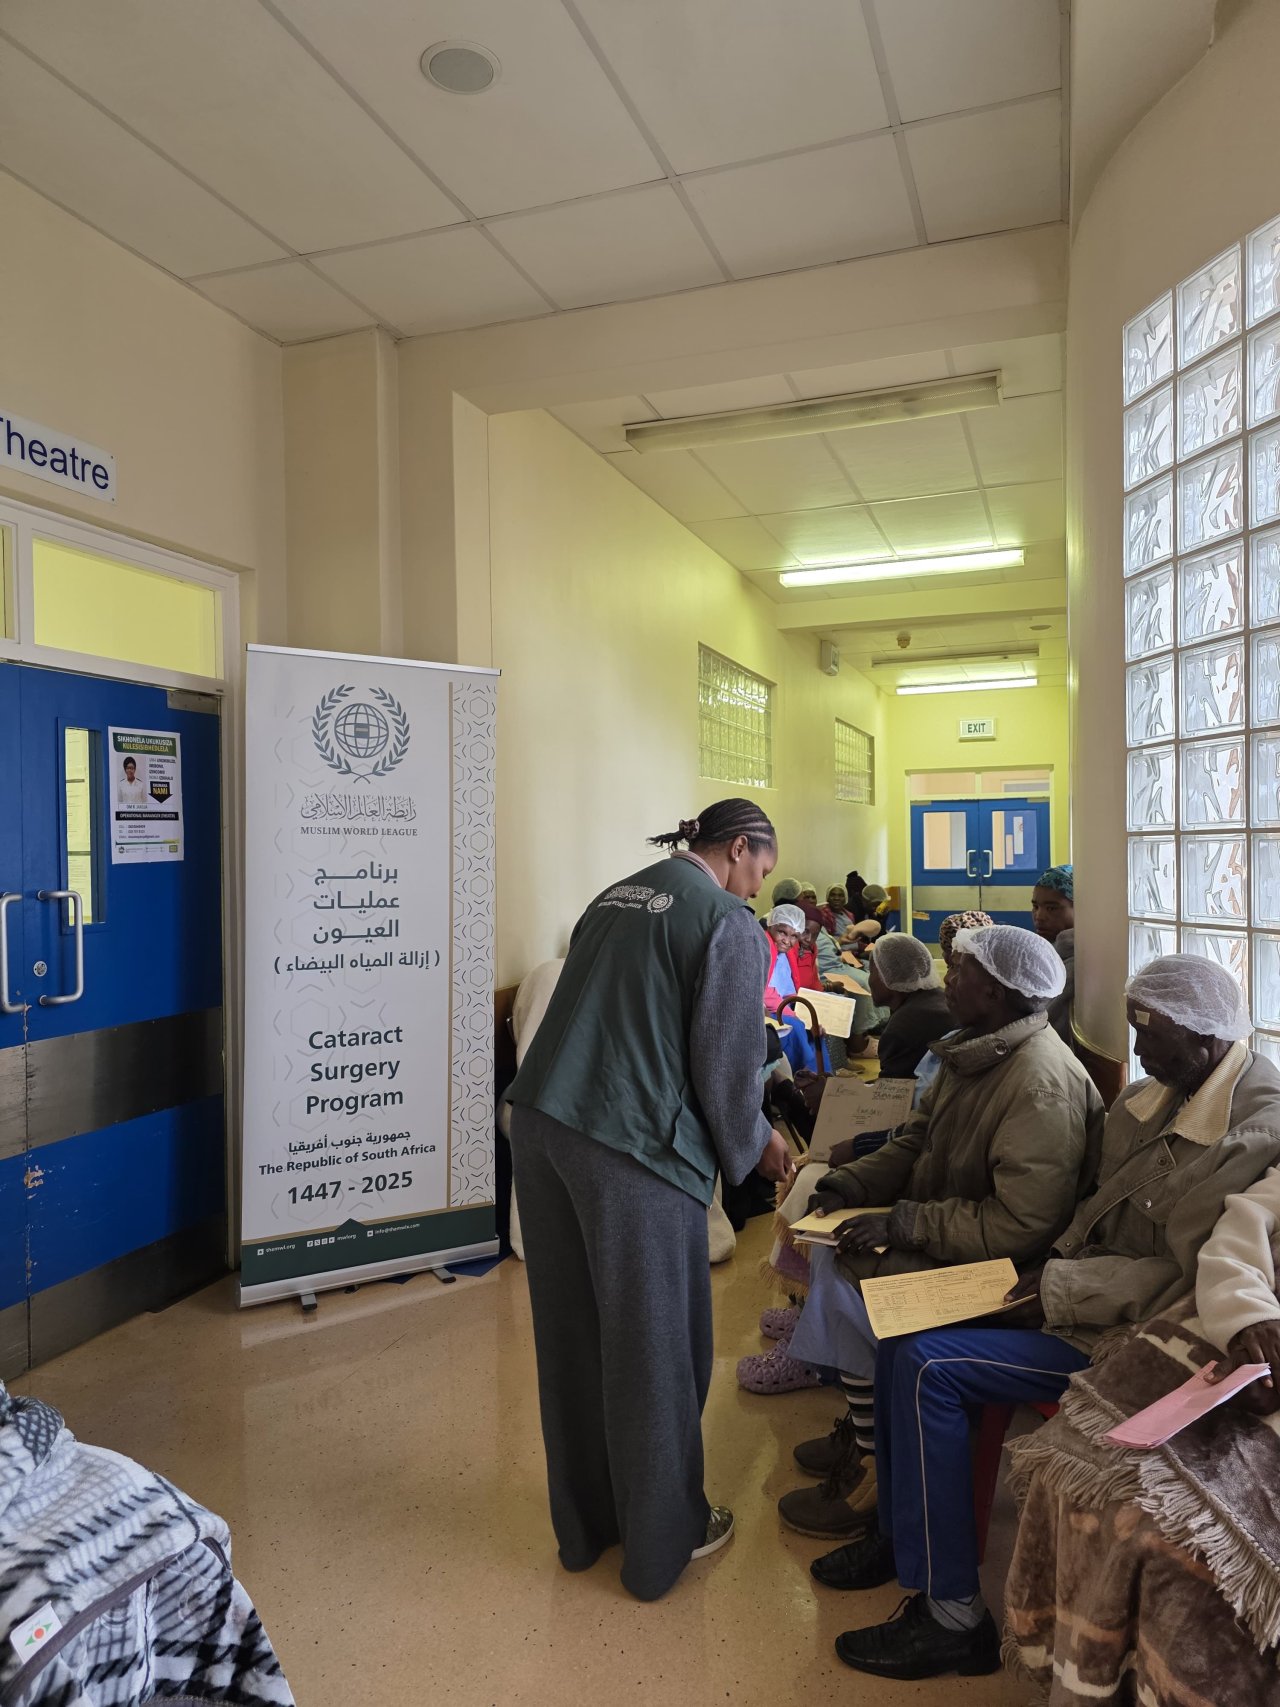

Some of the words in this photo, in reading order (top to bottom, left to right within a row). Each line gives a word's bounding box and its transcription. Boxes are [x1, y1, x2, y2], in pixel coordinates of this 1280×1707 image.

[0, 416, 109, 490] heatre
[967, 722, 986, 733] EXIT
[300, 826, 341, 835] MUSLIM
[343, 827, 379, 836] WORLD
[381, 828, 418, 836] LEAGUE
[308, 1026, 404, 1050] Cataract
[310, 1060, 401, 1083] Surgery
[306, 1089, 404, 1115] Program
[288, 1134, 328, 1155] أفريقيا
[331, 1135, 363, 1148] جنوب
[365, 1130, 411, 1144] جمهورية
[259, 1164, 283, 1175] The
[286, 1154, 342, 1172] Republic
[345, 1151, 359, 1163] of
[361, 1147, 398, 1161] South
[401, 1144, 436, 1157] Africa
[288, 1180, 342, 1204] 1447
[361, 1170, 413, 1194] 2025
